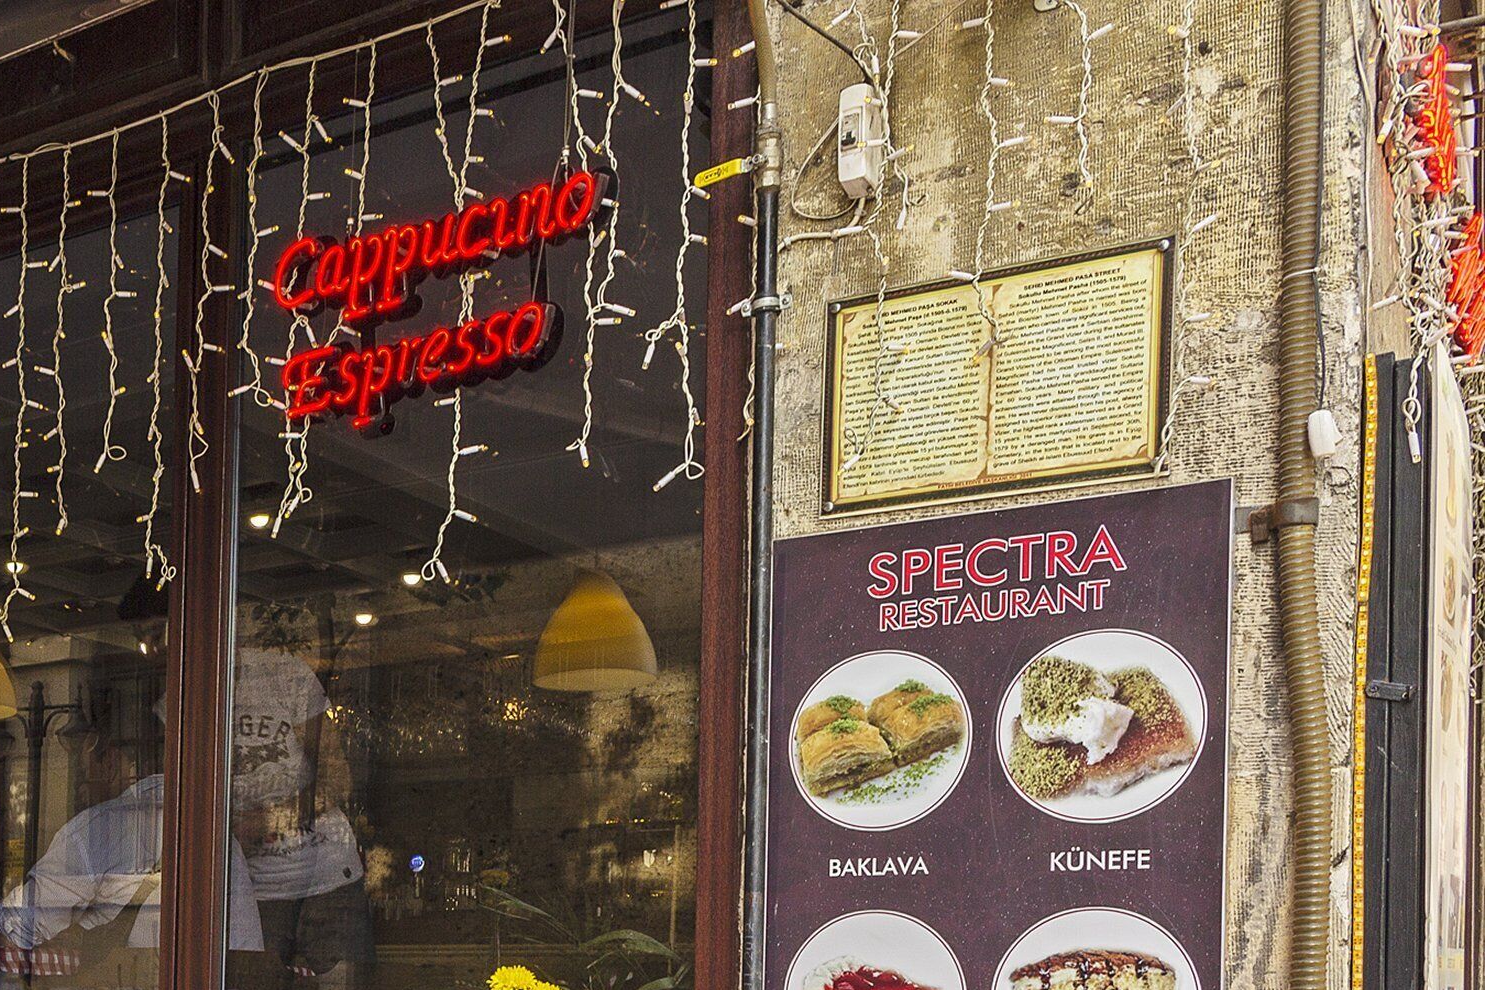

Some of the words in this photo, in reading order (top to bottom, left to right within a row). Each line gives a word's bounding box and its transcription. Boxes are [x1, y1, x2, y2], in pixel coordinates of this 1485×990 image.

[274, 171, 596, 321] Cappucino
[1023, 282, 1043, 290] SEHID
[1044, 277, 1073, 286] MEHMED
[1075, 273, 1092, 281] PASA
[1094, 268, 1119, 277] STREET
[935, 300, 957, 308] SOKAK
[281, 301, 546, 430] Espresso
[867, 525, 1127, 599] SPECTRA
[879, 579, 1111, 632] RESTAURANT
[239, 714, 291, 741] GER
[828, 856, 930, 879] BAKLAVA
[1049, 846, 1152, 873] KÜNEFE
